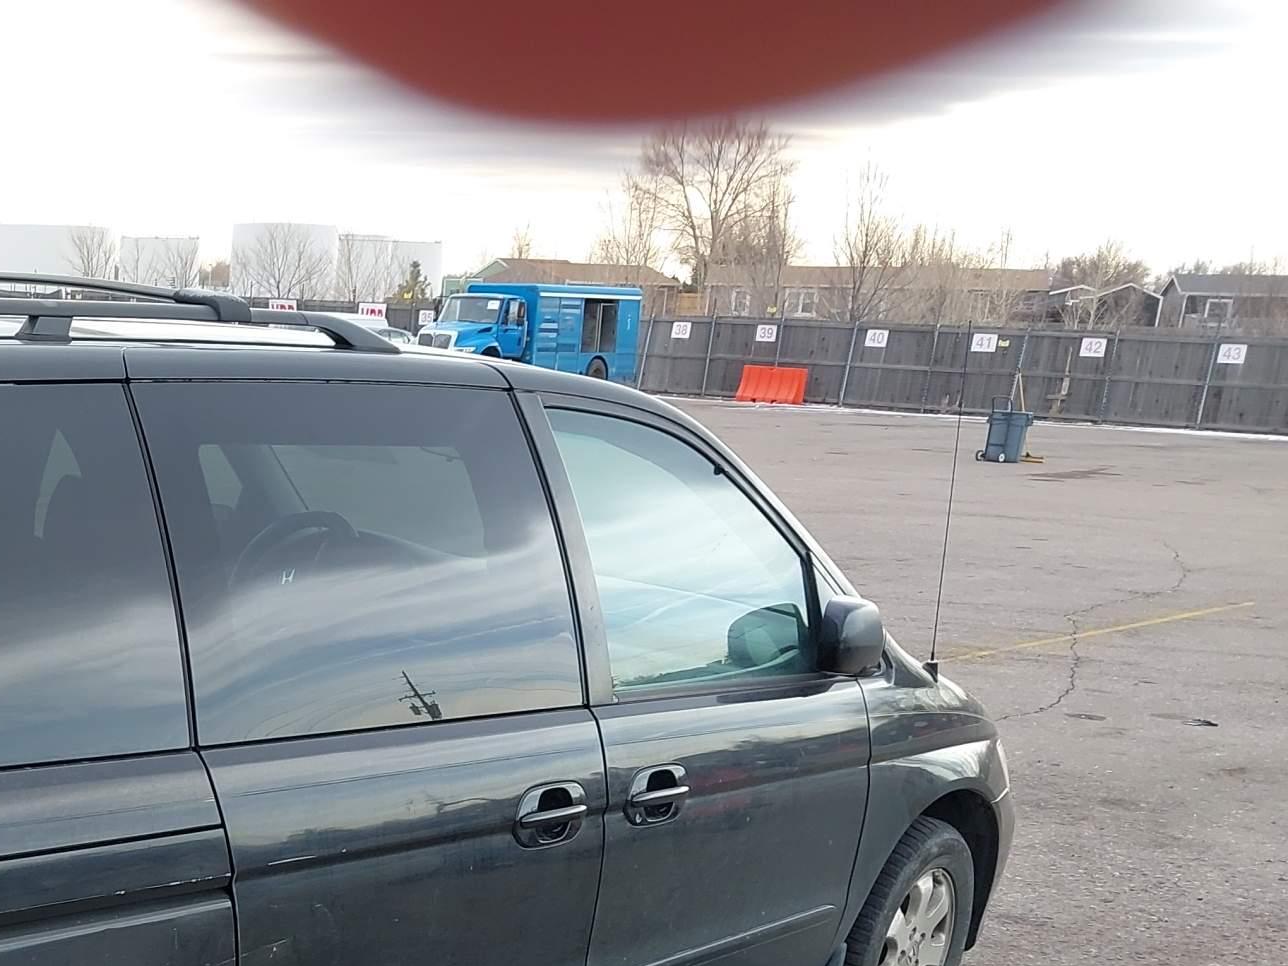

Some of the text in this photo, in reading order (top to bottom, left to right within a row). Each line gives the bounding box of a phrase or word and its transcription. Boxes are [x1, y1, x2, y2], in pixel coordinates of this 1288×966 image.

[674, 323, 688, 336] 38
[759, 327, 774, 339] 39
[869, 331, 886, 345] 40
[975, 336, 993, 349] 41
[1085, 340, 1104, 354] 42
[1223, 347, 1242, 361] 43
